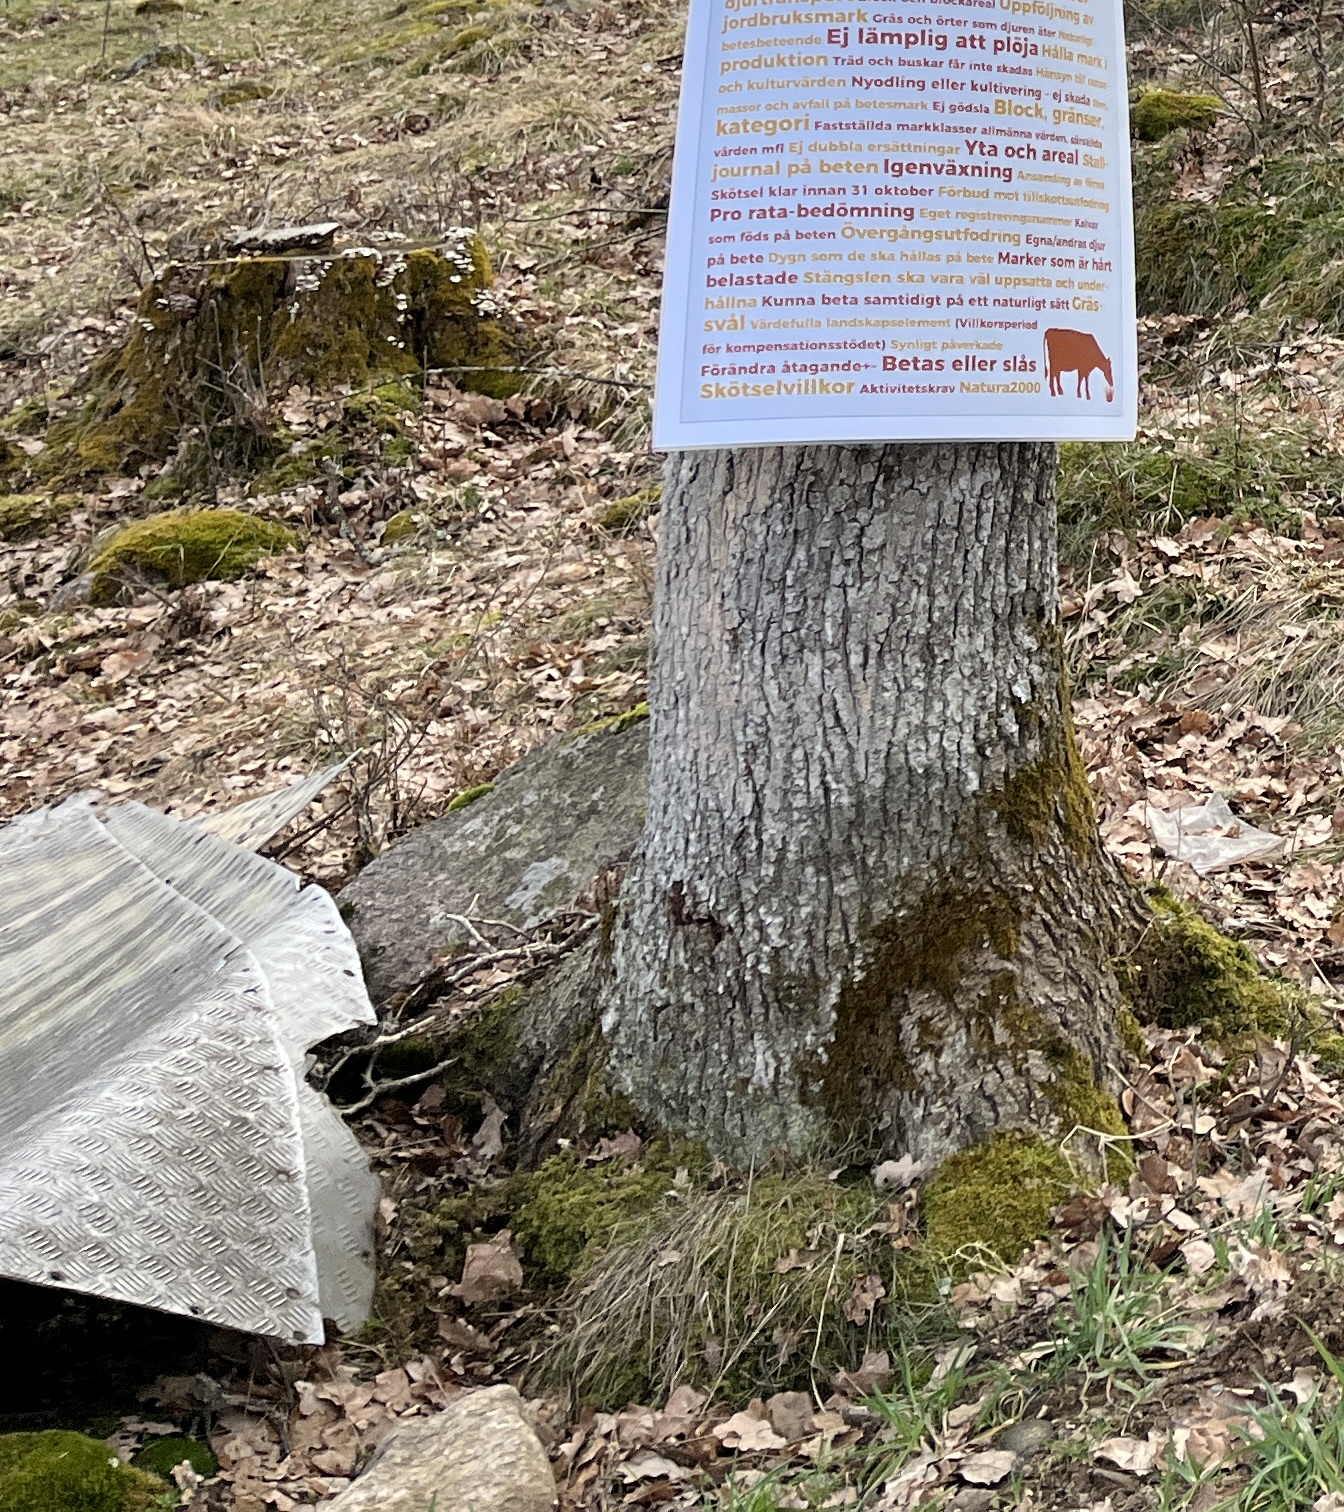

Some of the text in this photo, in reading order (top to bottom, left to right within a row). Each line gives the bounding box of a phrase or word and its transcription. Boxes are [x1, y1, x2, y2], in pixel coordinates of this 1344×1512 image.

[722, 8, 1035, 35] jordbruksmark Gräs och örter som djuren
[1083, 14, 1095, 25] av
[722, 35, 822, 52] betesbeteende
[827, 27, 849, 48] Ej
[858, 27, 948, 51] lämplig
[956, 34, 986, 50] att
[994, 35, 1038, 58] plöja
[1042, 43, 1074, 61] Hålla
[720, 52, 1033, 76] produktion Träd och buskar får inte skadas
[718, 76, 1062, 103] och kulturvärden Nyodling eller kultivering ej
[765, 100, 789, 111] och
[793, 99, 829, 110] avfall
[834, 97, 851, 111] på
[855, 99, 928, 111] betesmark
[932, 101, 944, 113] Ej
[949, 101, 990, 114] gödsla
[994, 99, 1047, 121] Block,
[716, 113, 1033, 138] kategori Fastställda markklasser allmänna
[714, 146, 757, 157] värden
[762, 143, 784, 155] mfl
[788, 140, 803, 155] Ej
[808, 141, 863, 153] dubbla
[868, 141, 960, 156] ersättningar
[965, 139, 998, 157] Yta
[1005, 143, 1037, 161] och
[1042, 149, 1079, 165] areal
[710, 158, 1013, 183] journal på beten Igenväxning
[711, 185, 1019, 202] Skötsel klar innan 31 oktober Förbud mot
[710, 202, 951, 222] Pro rata-bedömning Eget
[708, 234, 736, 244] som
[740, 231, 769, 242] föds
[774, 229, 791, 243] på
[795, 229, 836, 240] beten
[840, 222, 1021, 246] Övergångsutfodring
[706, 250, 1112, 272] på bete Dygn som de ska hållas på bete Marker som är hårt
[706, 269, 1074, 289] belastade Stängslen ska vara väl uppsatta och
[704, 294, 1103, 312] hållna Kunna beta samtidigt på ett naturligt sätt Gräs-
[703, 314, 1038, 332] svål landskapselement (Villkorsperiod
[702, 344, 721, 355] för
[726, 339, 886, 354] kompensationsstödet)
[890, 339, 937, 351] Synligt
[701, 353, 1036, 377] Förändra Betas eller slås
[700, 378, 1041, 399] Skötselvillkor Aktivitetskrav Natura2000
